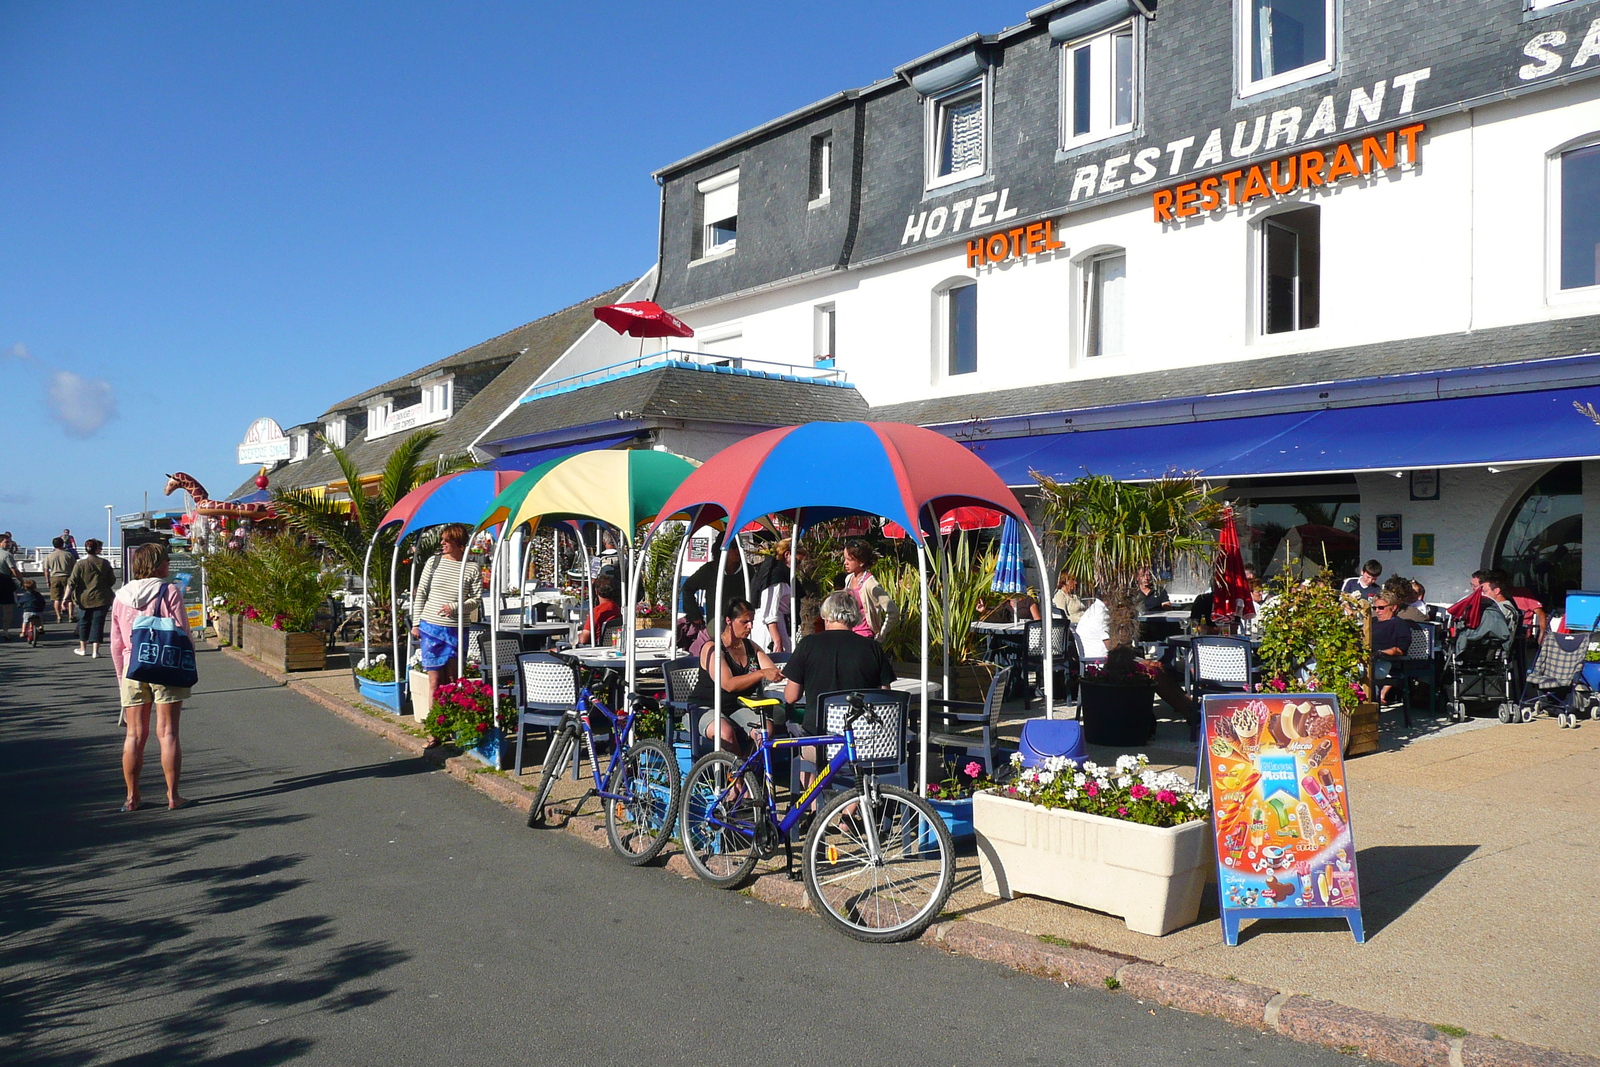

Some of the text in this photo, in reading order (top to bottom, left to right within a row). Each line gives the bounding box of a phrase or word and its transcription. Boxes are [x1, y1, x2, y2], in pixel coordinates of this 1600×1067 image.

[901, 188, 1018, 246] HOTEL
[1069, 67, 1431, 203] RESTAURANT
[966, 123, 1425, 268] HOTEL RESTAURANT
[1262, 771, 1295, 780] Motta
